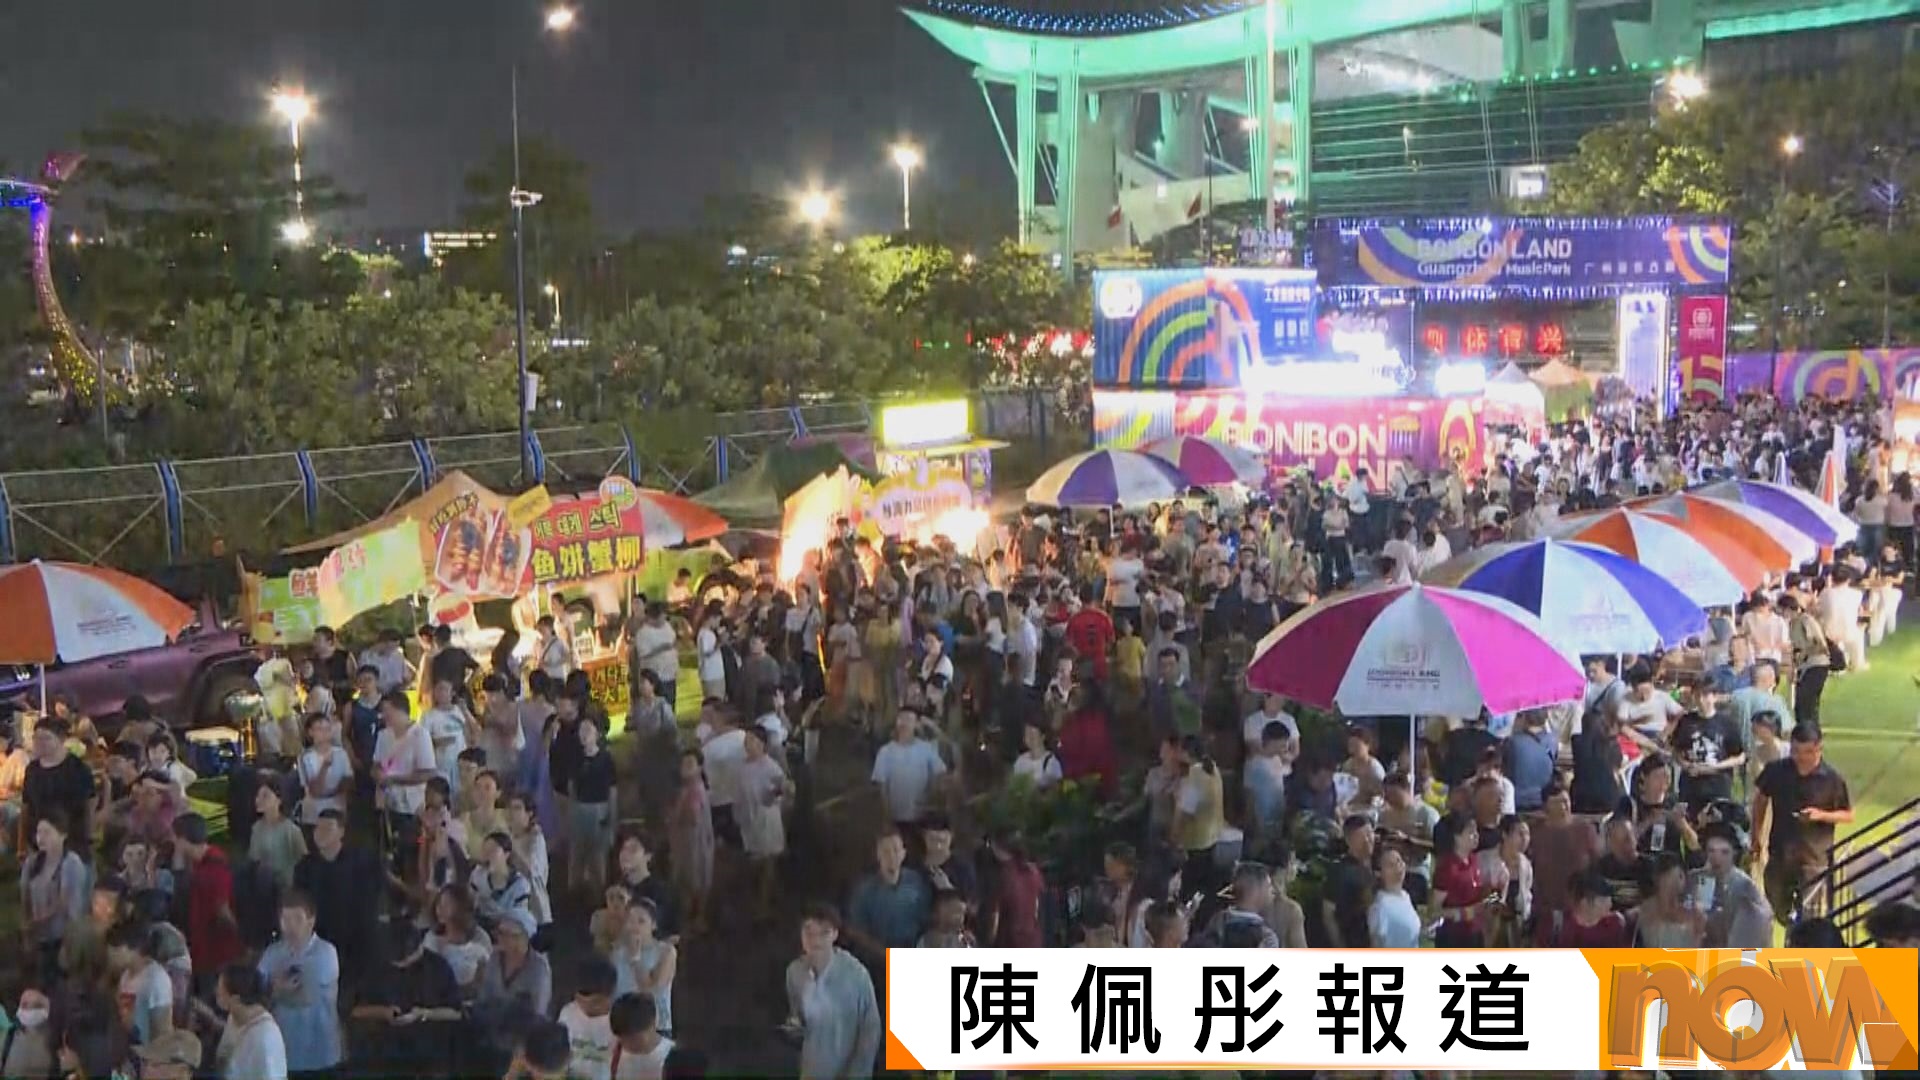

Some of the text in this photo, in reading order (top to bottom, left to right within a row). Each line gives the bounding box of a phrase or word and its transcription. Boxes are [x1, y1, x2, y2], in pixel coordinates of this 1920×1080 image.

[1511, 238, 1572, 259] LAND
[1417, 260, 1502, 277] Guangzhu
[1222, 420, 1388, 457] BONBON
